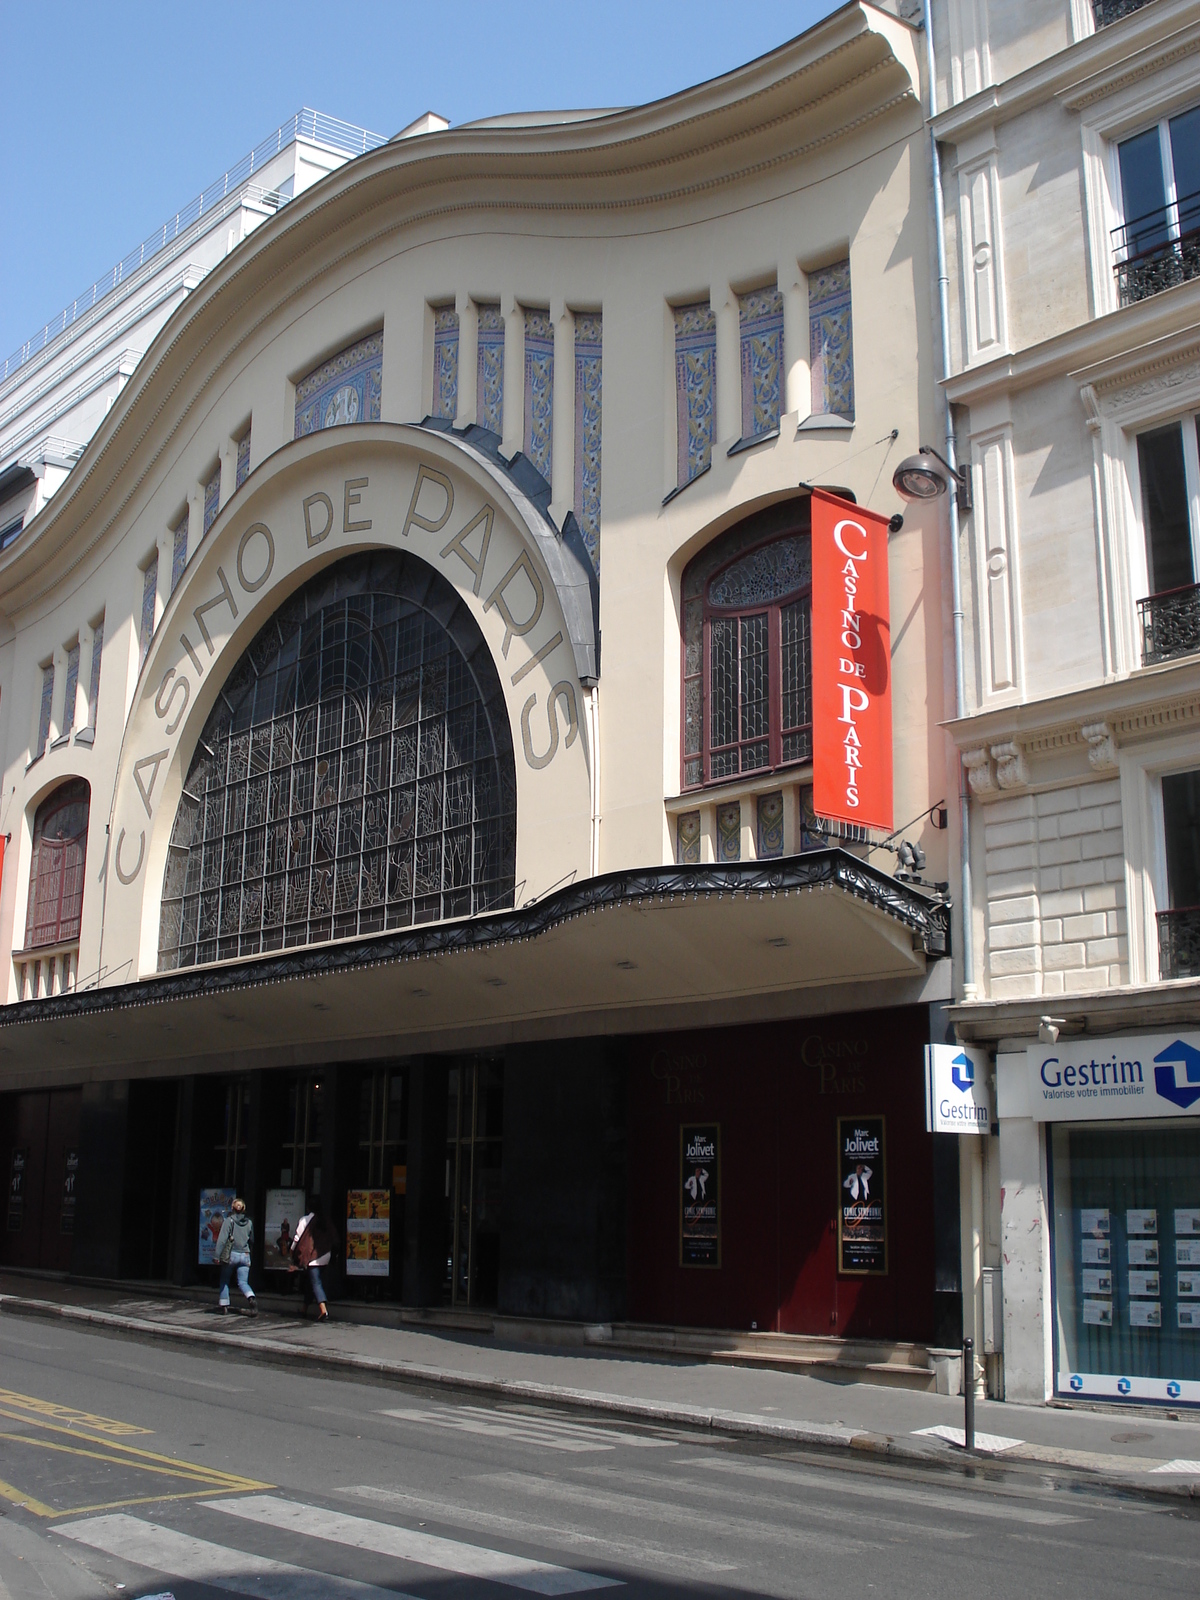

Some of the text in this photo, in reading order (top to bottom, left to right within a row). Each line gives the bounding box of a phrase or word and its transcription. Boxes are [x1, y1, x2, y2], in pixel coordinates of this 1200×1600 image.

[833, 519, 869, 808] CASINO DE PARIS
[115, 464, 579, 885] CASINO DE PARIS
[1040, 1055, 1144, 1087] Gestrim
[1043, 1085, 1145, 1099] Valorise votre immobilier
[939, 1099, 988, 1120] Gestrim
[854, 1129, 869, 1137] Marc
[686, 1142, 715, 1157] Jolivet
[844, 1137, 879, 1152] Jolivet
